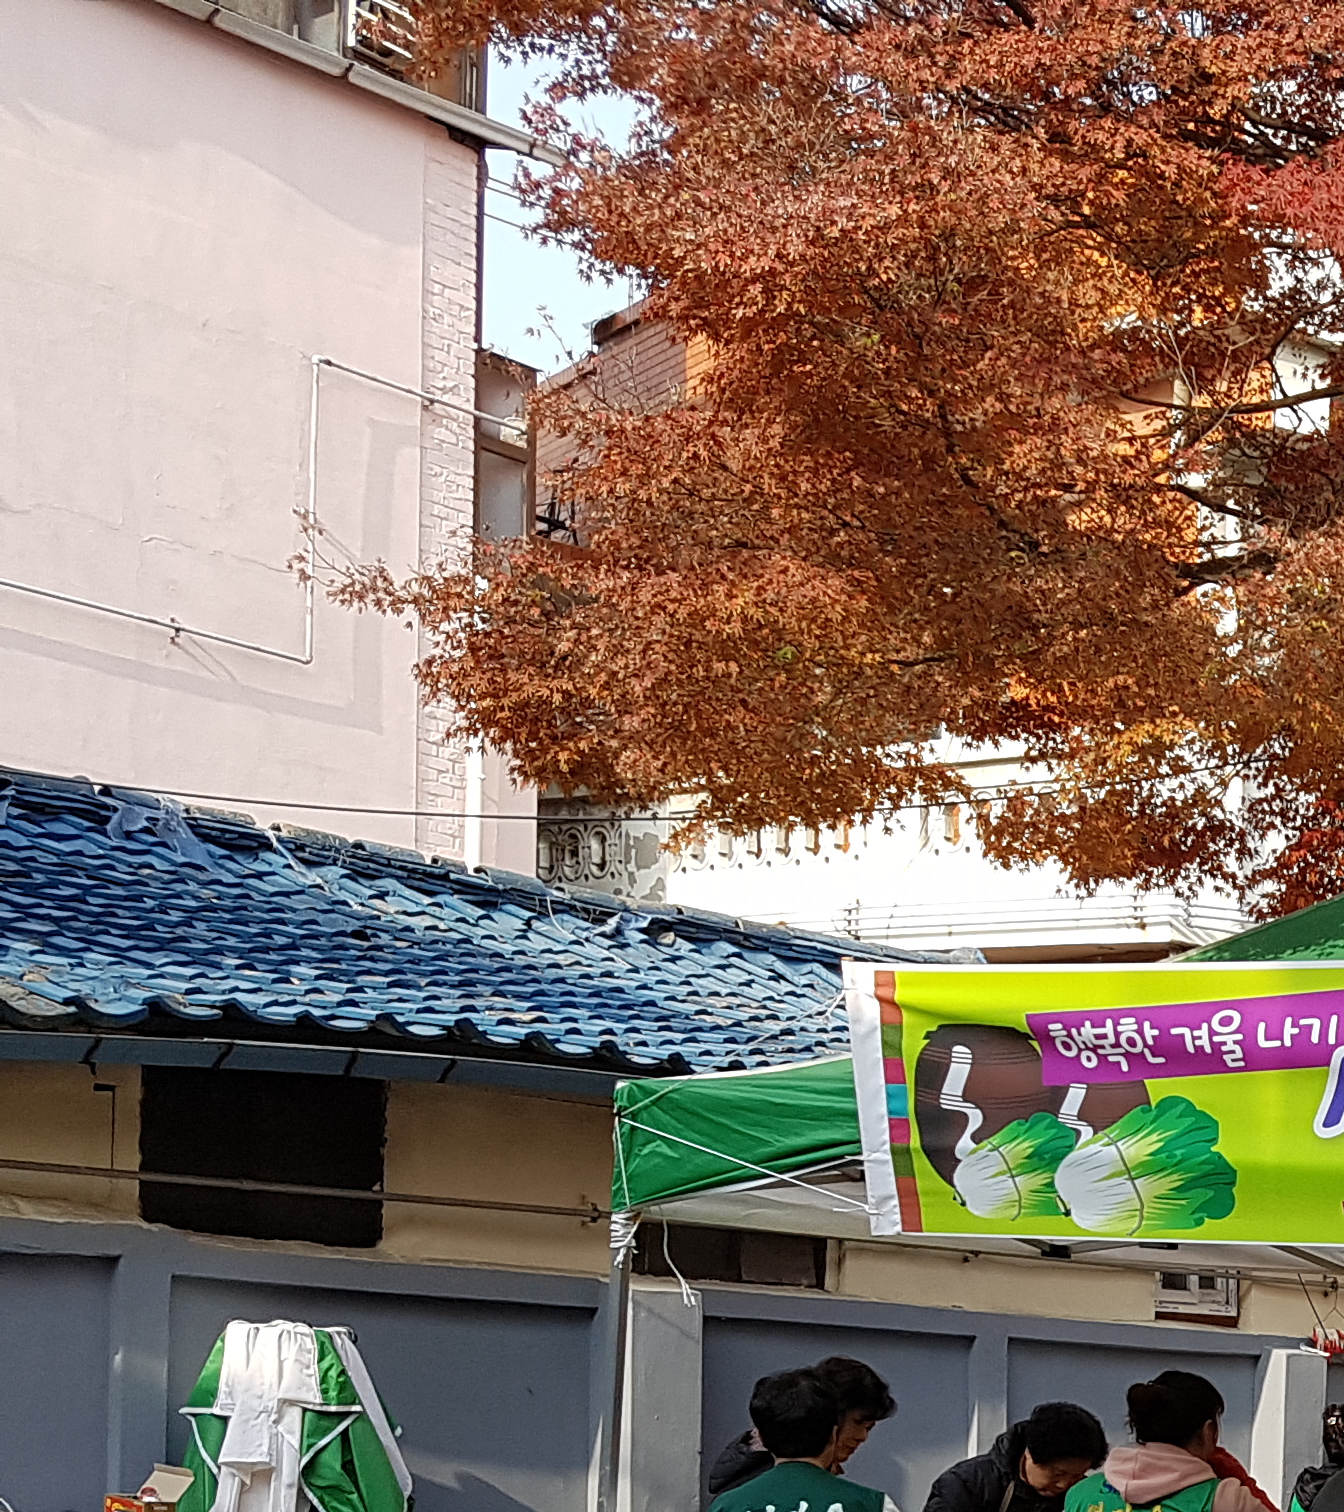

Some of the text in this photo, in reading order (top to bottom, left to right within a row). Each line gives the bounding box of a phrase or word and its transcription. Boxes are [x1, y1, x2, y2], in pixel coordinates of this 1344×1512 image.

[1047, 1009, 1339, 1073] 행복한 겨울 나기
